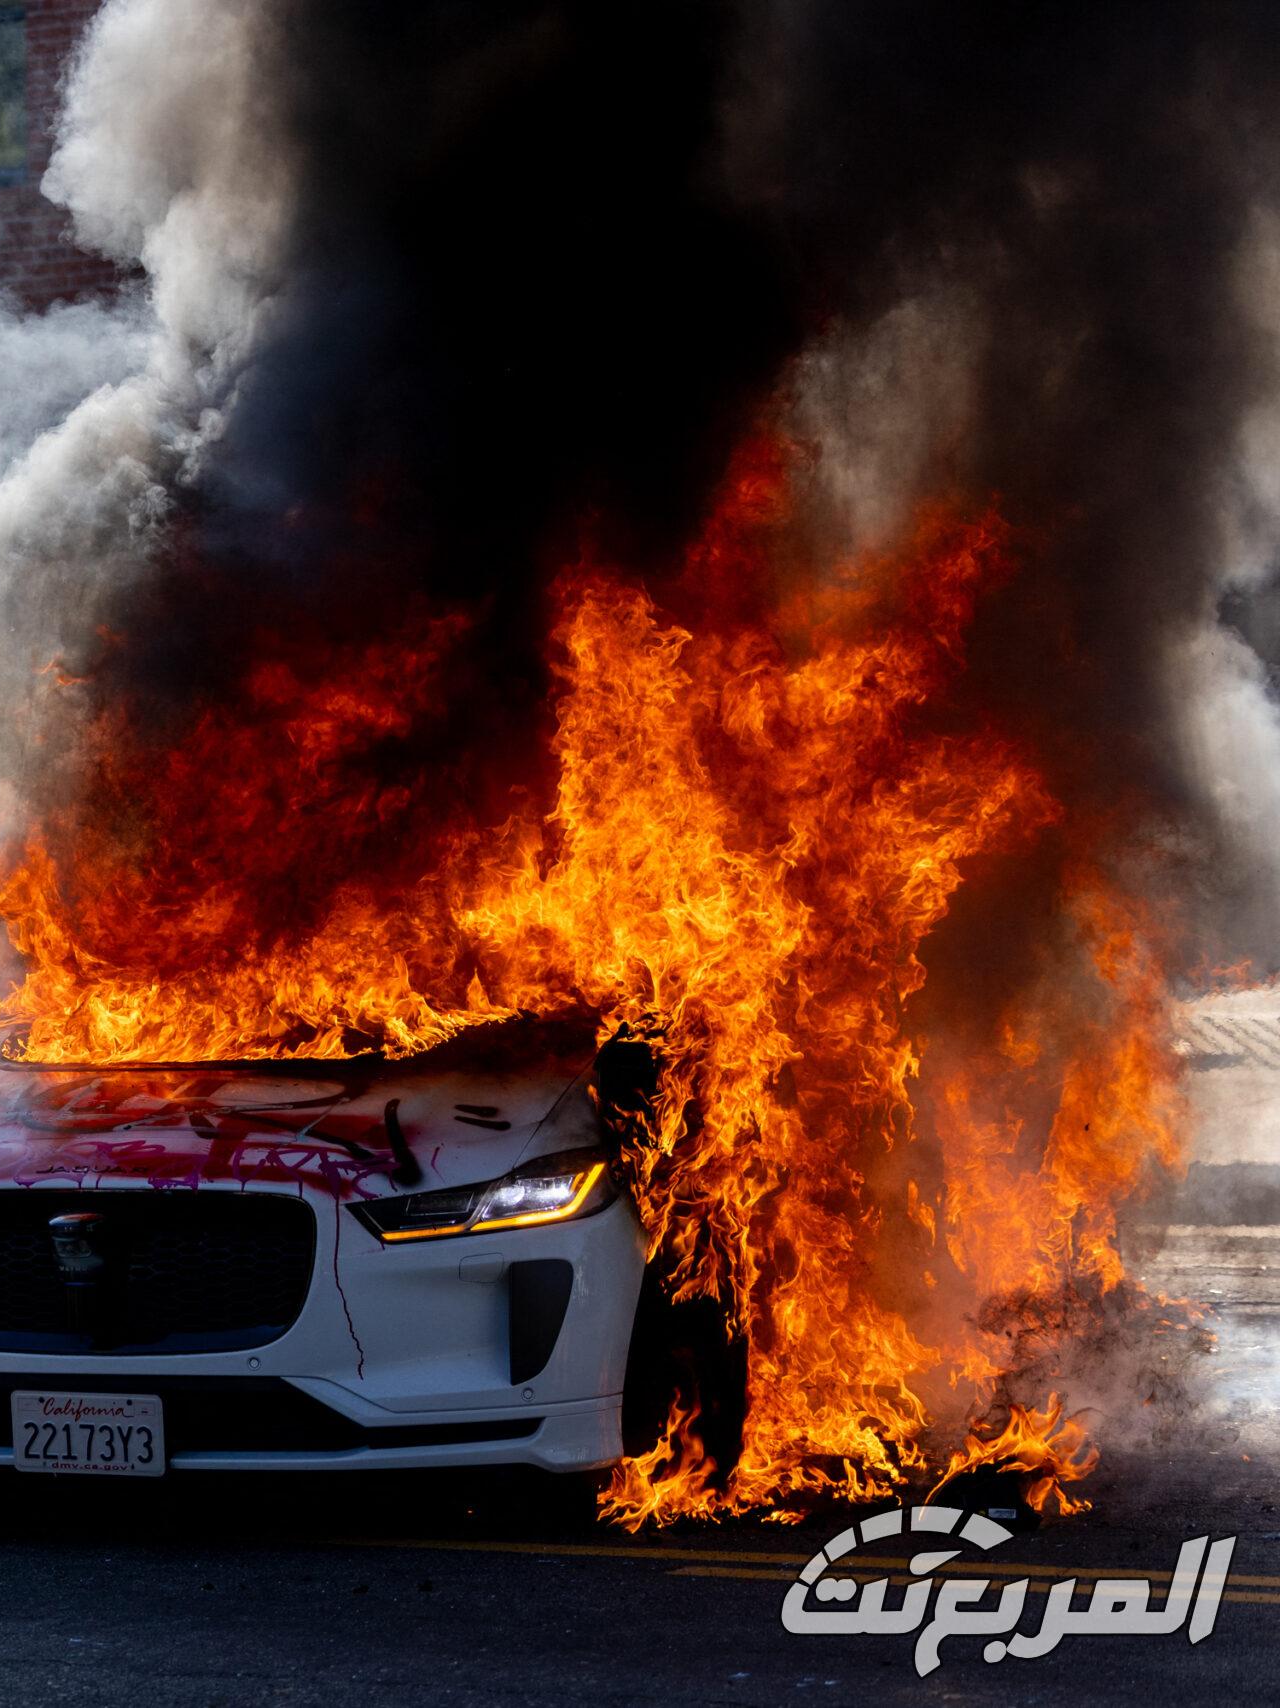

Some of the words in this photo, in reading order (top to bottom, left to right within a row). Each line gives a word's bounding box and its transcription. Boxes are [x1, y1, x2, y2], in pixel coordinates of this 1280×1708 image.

[43, 1397, 133, 1422] California
[24, 1421, 154, 1464] 22173Y3
[51, 1461, 128, 1472] dmv.ca.gov
